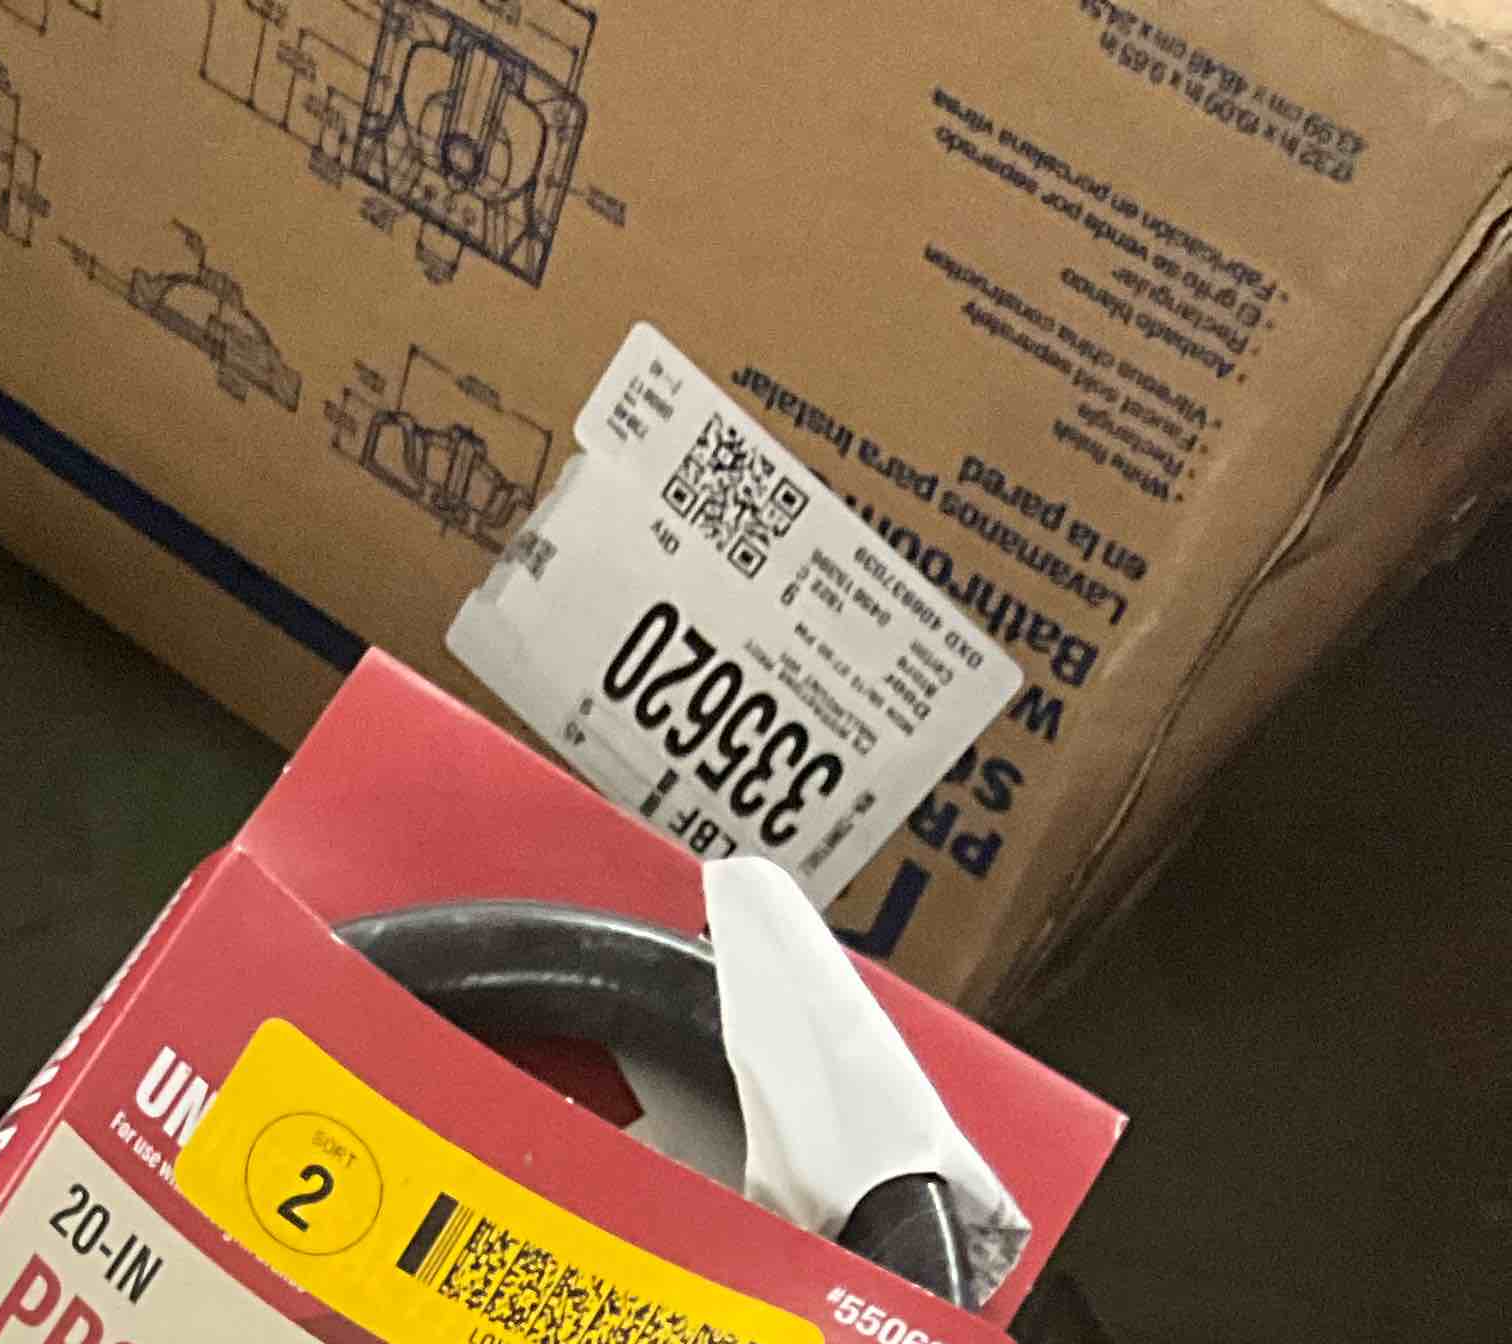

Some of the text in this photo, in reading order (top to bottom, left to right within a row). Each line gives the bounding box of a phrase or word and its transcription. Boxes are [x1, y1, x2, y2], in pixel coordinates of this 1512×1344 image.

[857, 437, 939, 502] para
[645, 516, 684, 556] Qty
[938, 489, 1128, 626] Lavamanos
[956, 454, 1147, 581] en la pared
[602, 601, 843, 847] 335620
[132, 1136, 161, 1168] use
[276, 1163, 334, 1232] 2
[48, 1183, 163, 1304] 20-IN
